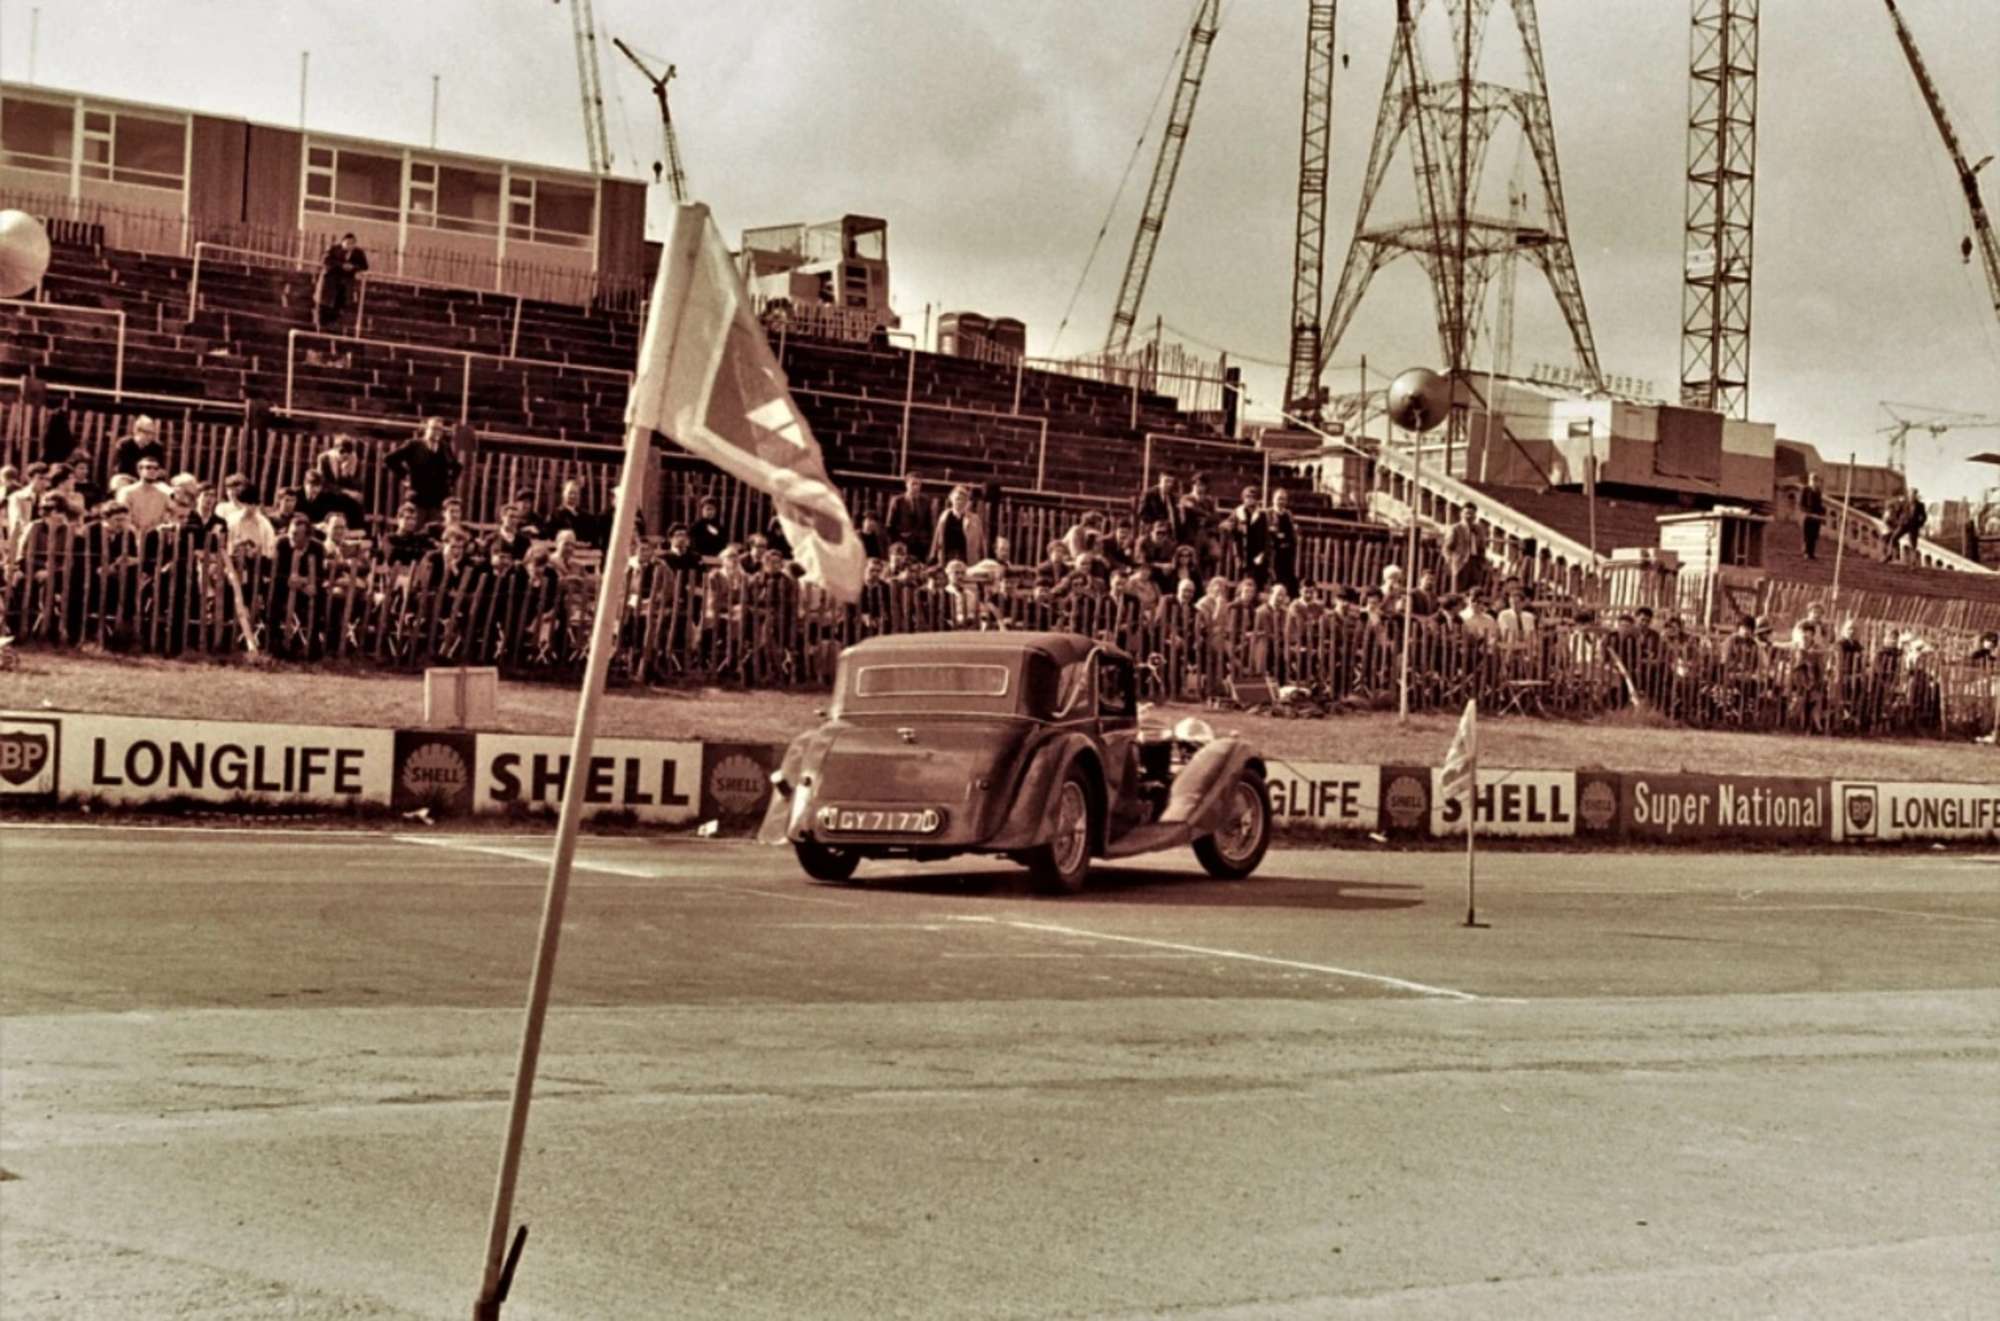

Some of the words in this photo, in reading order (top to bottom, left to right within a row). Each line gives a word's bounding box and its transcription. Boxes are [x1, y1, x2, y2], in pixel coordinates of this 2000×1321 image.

[0, 741, 43, 771] BP
[93, 737, 365, 794] LONGLIFE
[411, 766, 460, 784] SHELL
[490, 753, 690, 806] SHELL
[716, 777, 759, 793] SHELL
[1442, 784, 1570, 822] SHELL
[1634, 781, 1710, 833] Super
[1718, 784, 1823, 827] National
[1892, 797, 2000, 828] LONGLIFE
